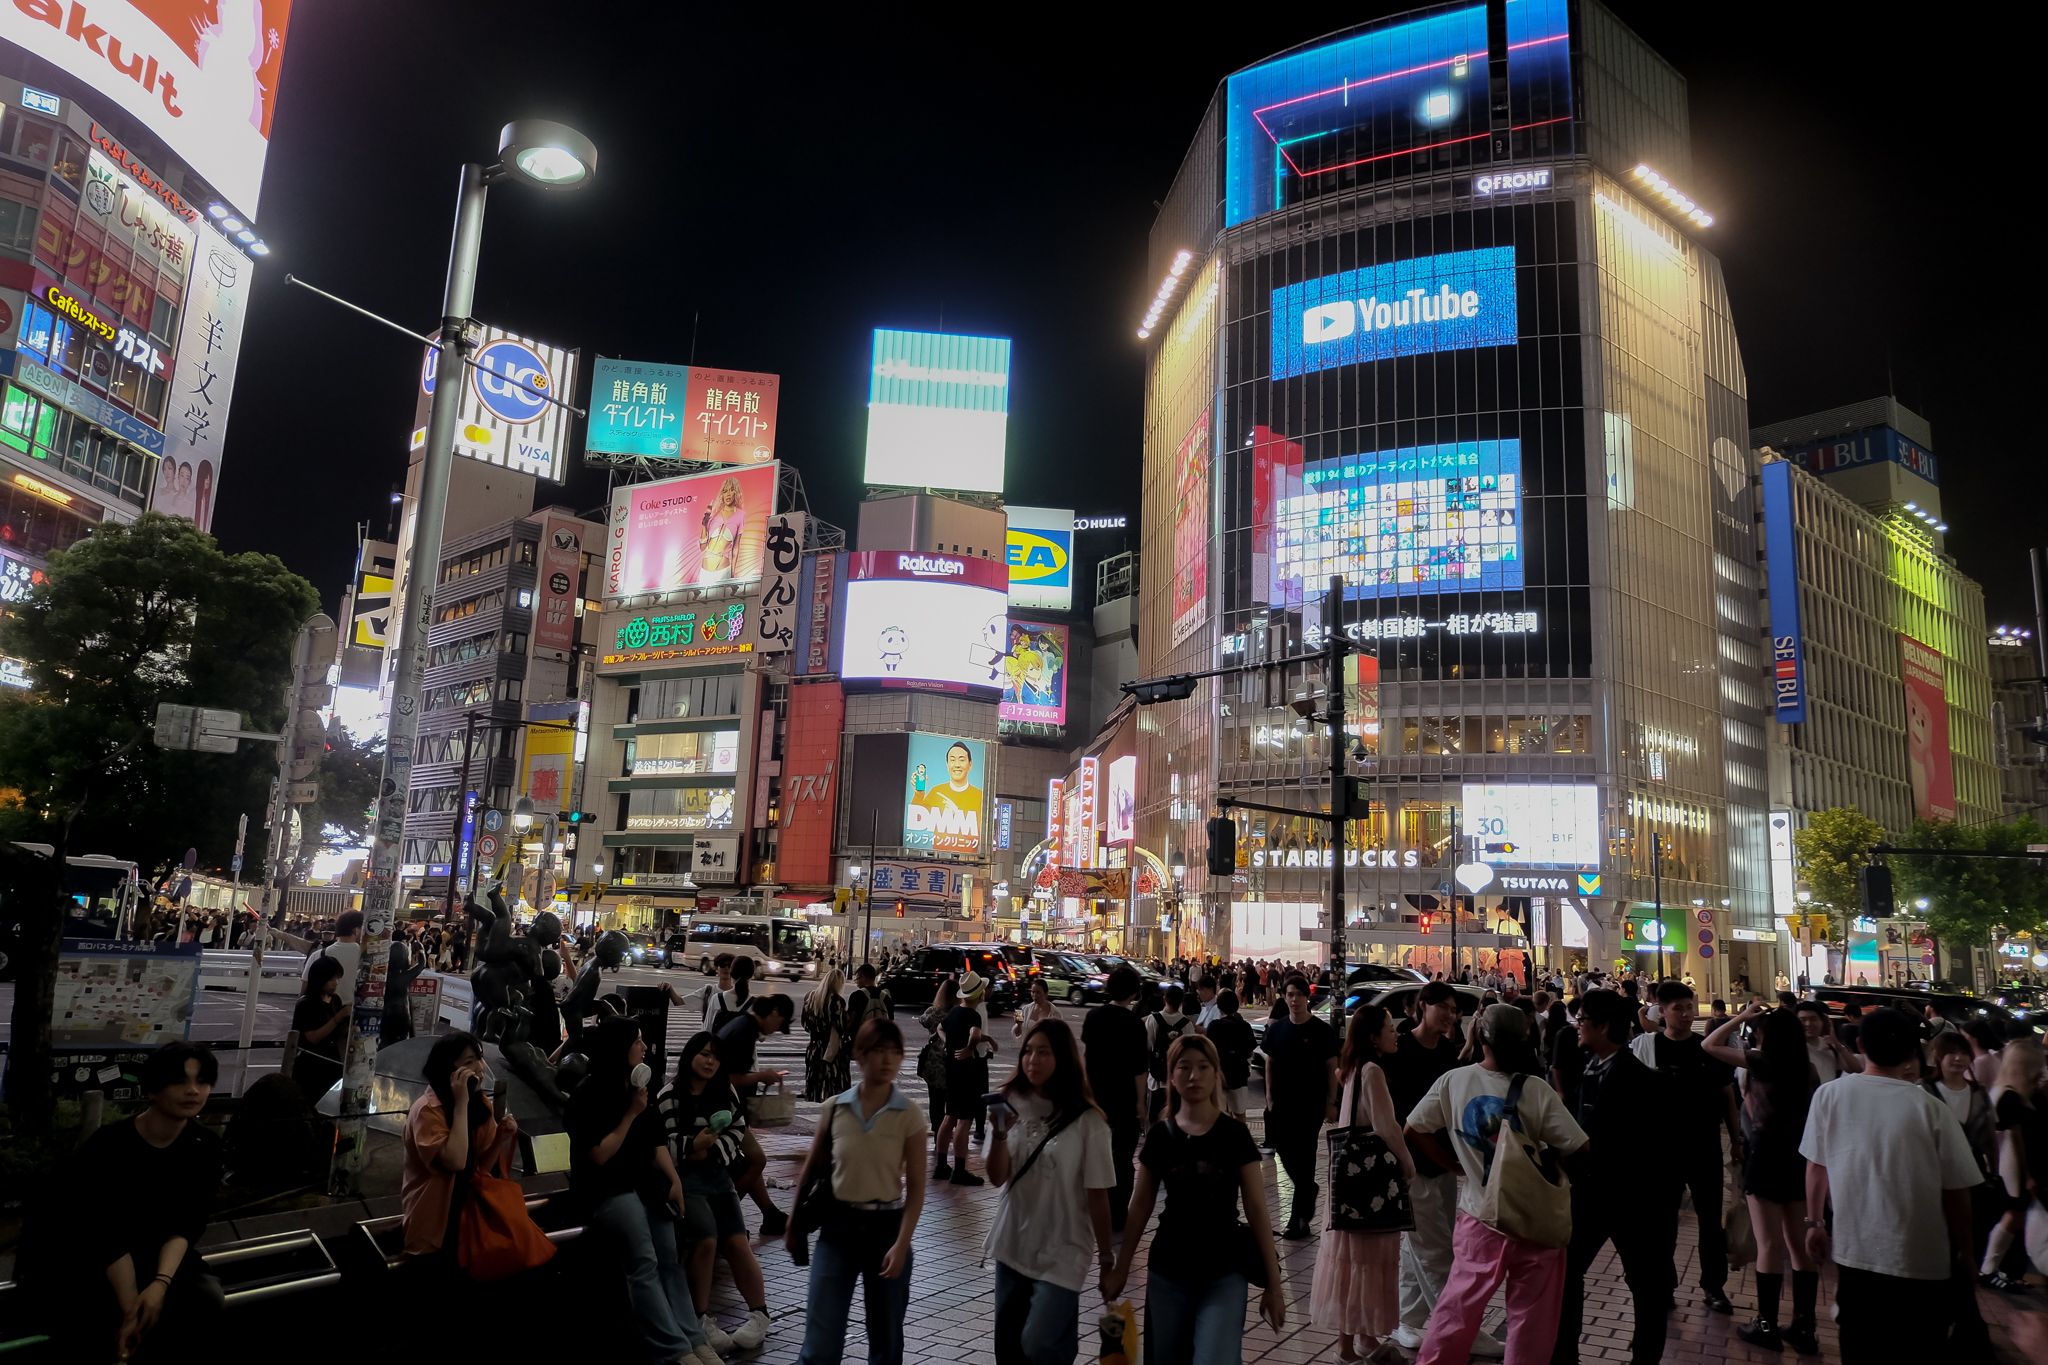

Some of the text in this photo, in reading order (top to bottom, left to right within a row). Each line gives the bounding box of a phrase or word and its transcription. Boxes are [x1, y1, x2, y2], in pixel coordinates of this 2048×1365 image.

[91, 121, 200, 223] しゃぶしゃぶバイキング
[1477, 170, 1550, 194] QFRONT
[1358, 284, 1479, 332] YouTube
[115, 328, 165, 374] ガスト
[25, 364, 63, 397] AEON
[183, 311, 225, 446] 羊文学
[612, 379, 668, 405] 龍角散
[705, 387, 761, 414] 龍角散
[518, 442, 550, 463] VISA
[1898, 439, 1935, 482] SEIBU
[640, 499, 661, 512] Coke
[899, 556, 964, 575] Rakuten
[758, 517, 800, 648] もんじゃ
[650, 622, 694, 647] 西村
[1774, 635, 1798, 710] SEIBU
[1081, 766, 1094, 821] カラオケ
[906, 804, 980, 836] DMM
[1477, 817, 1504, 836] 30
[906, 832, 980, 849] オンラインクリニック
[1500, 877, 1569, 890] TSUTAYA
